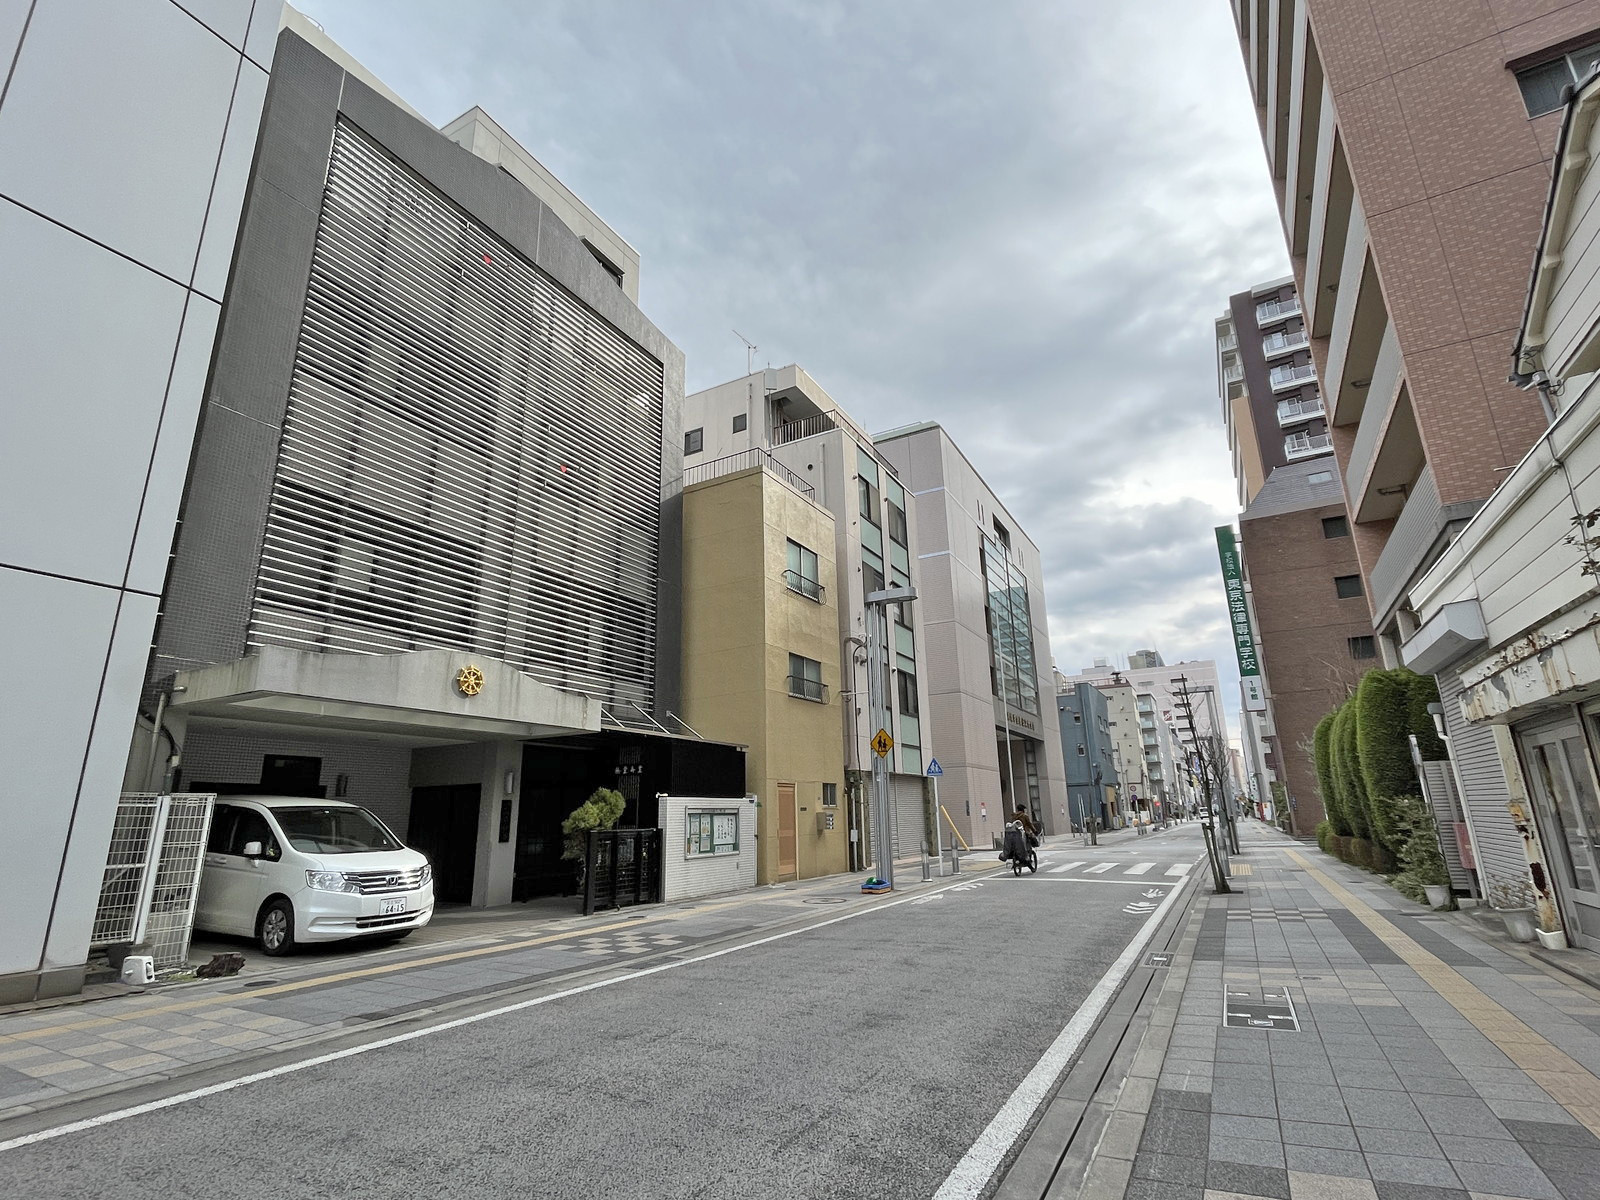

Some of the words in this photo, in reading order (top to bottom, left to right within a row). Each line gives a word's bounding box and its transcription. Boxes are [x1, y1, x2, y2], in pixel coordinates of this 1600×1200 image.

[1227, 578, 1256, 670] 東京法律専門学校
